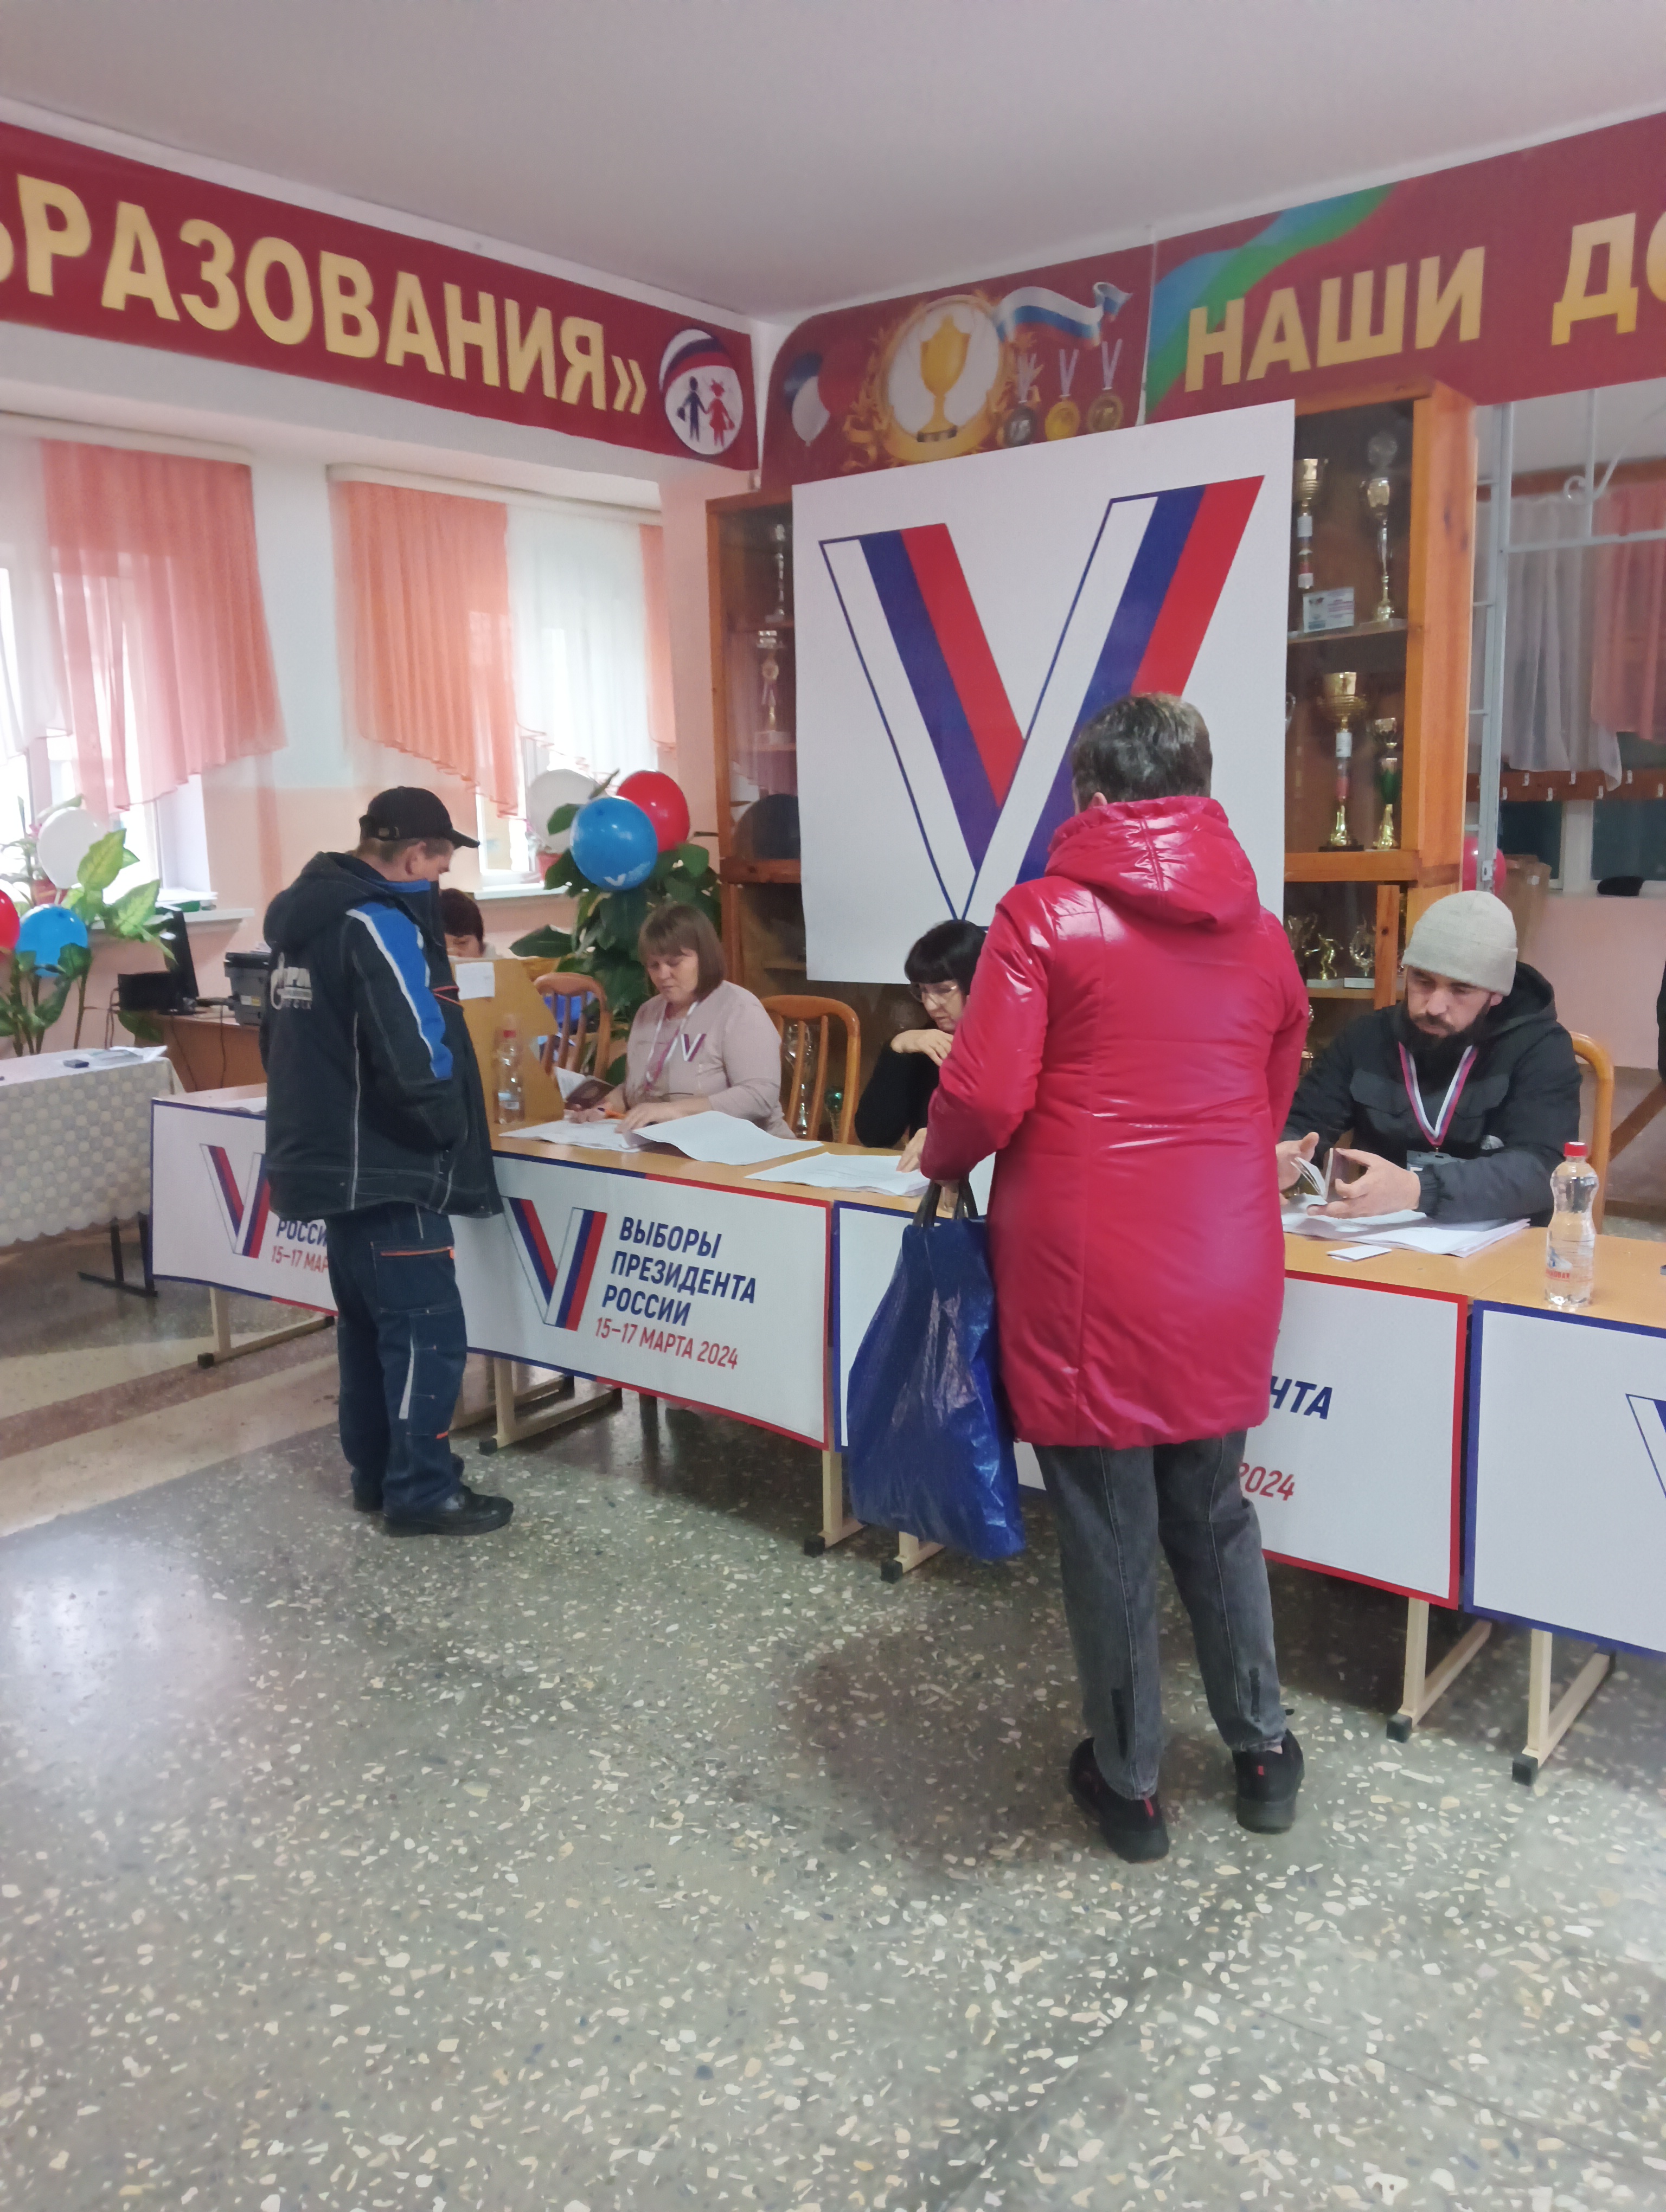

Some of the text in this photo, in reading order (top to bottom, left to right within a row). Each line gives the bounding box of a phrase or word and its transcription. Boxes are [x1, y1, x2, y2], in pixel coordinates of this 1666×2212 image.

[0, 173, 647, 414] РАЗОВАНИЯ»
[1184, 246, 1485, 393] НАШИ
[276, 1219, 328, 1247] РОССИ
[619, 1216, 722, 1258] ВЫБОРЫ
[611, 1251, 756, 1304] ПРЕЗИДЕНТА
[602, 1284, 691, 1326] РОССИИ
[639, 1327, 694, 1359] МАРТА
[697, 1341, 738, 1370] 2024
